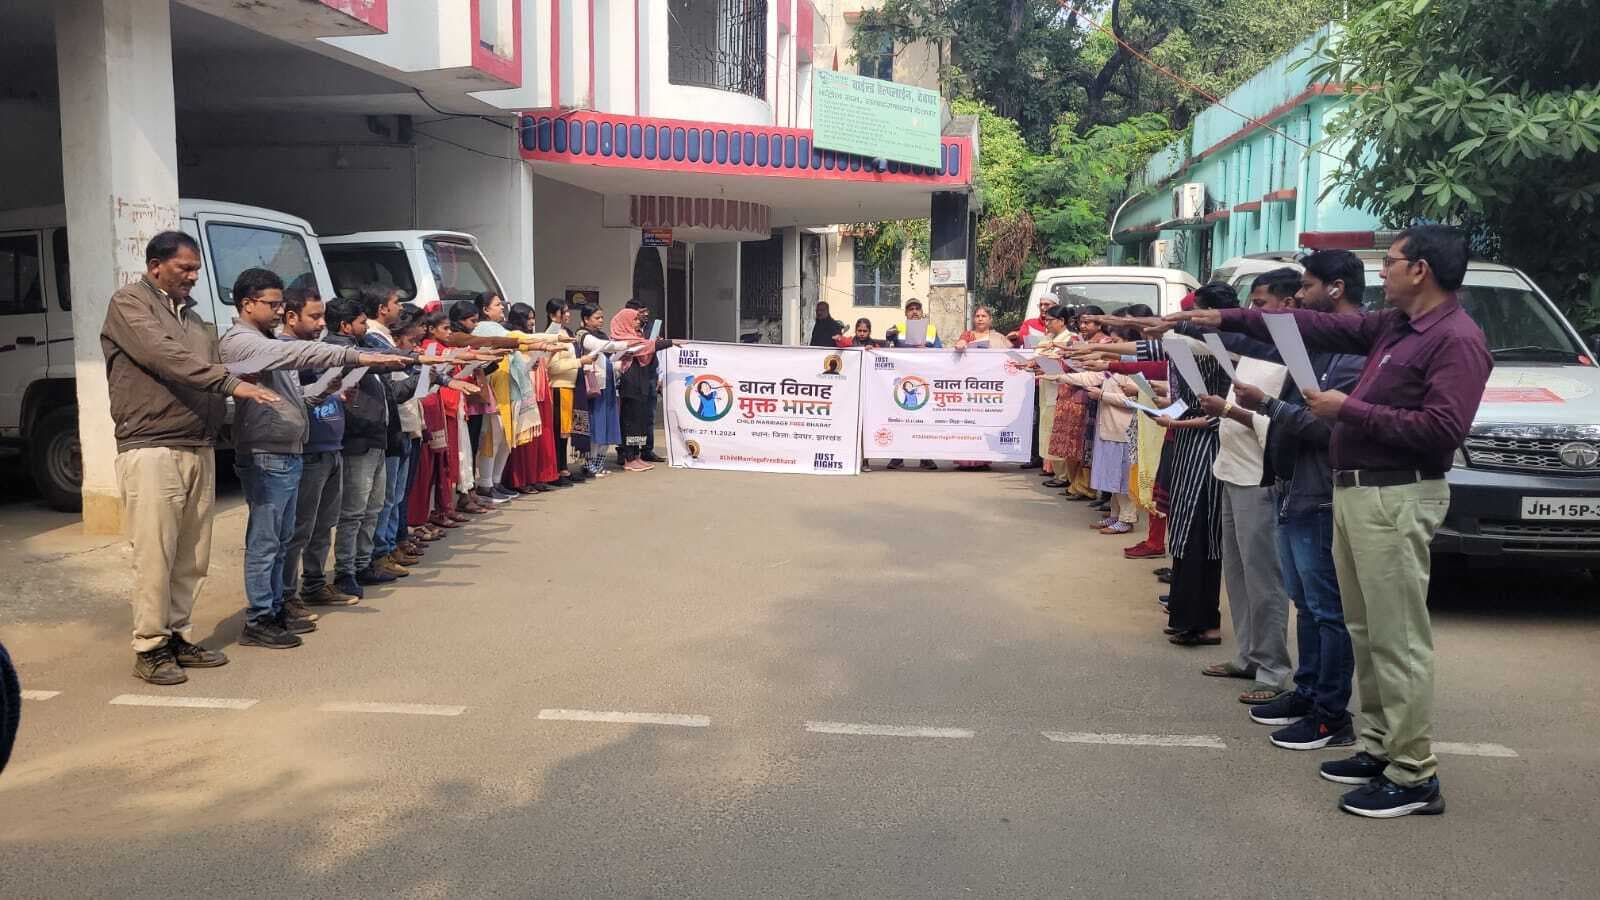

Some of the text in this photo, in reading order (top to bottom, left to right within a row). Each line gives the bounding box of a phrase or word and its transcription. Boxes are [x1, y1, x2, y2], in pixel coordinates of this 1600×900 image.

[678, 357, 708, 366] RIGHTS
[738, 378, 833, 399] बाल विवाह
[933, 377, 1004, 391] बाल विवाह
[933, 391, 1004, 407] मुक्त भारत
[738, 397, 832, 419] मुक्त भारत
[699, 429, 736, 437] 27.11.2024
[813, 460, 843, 469] RIGHTS
